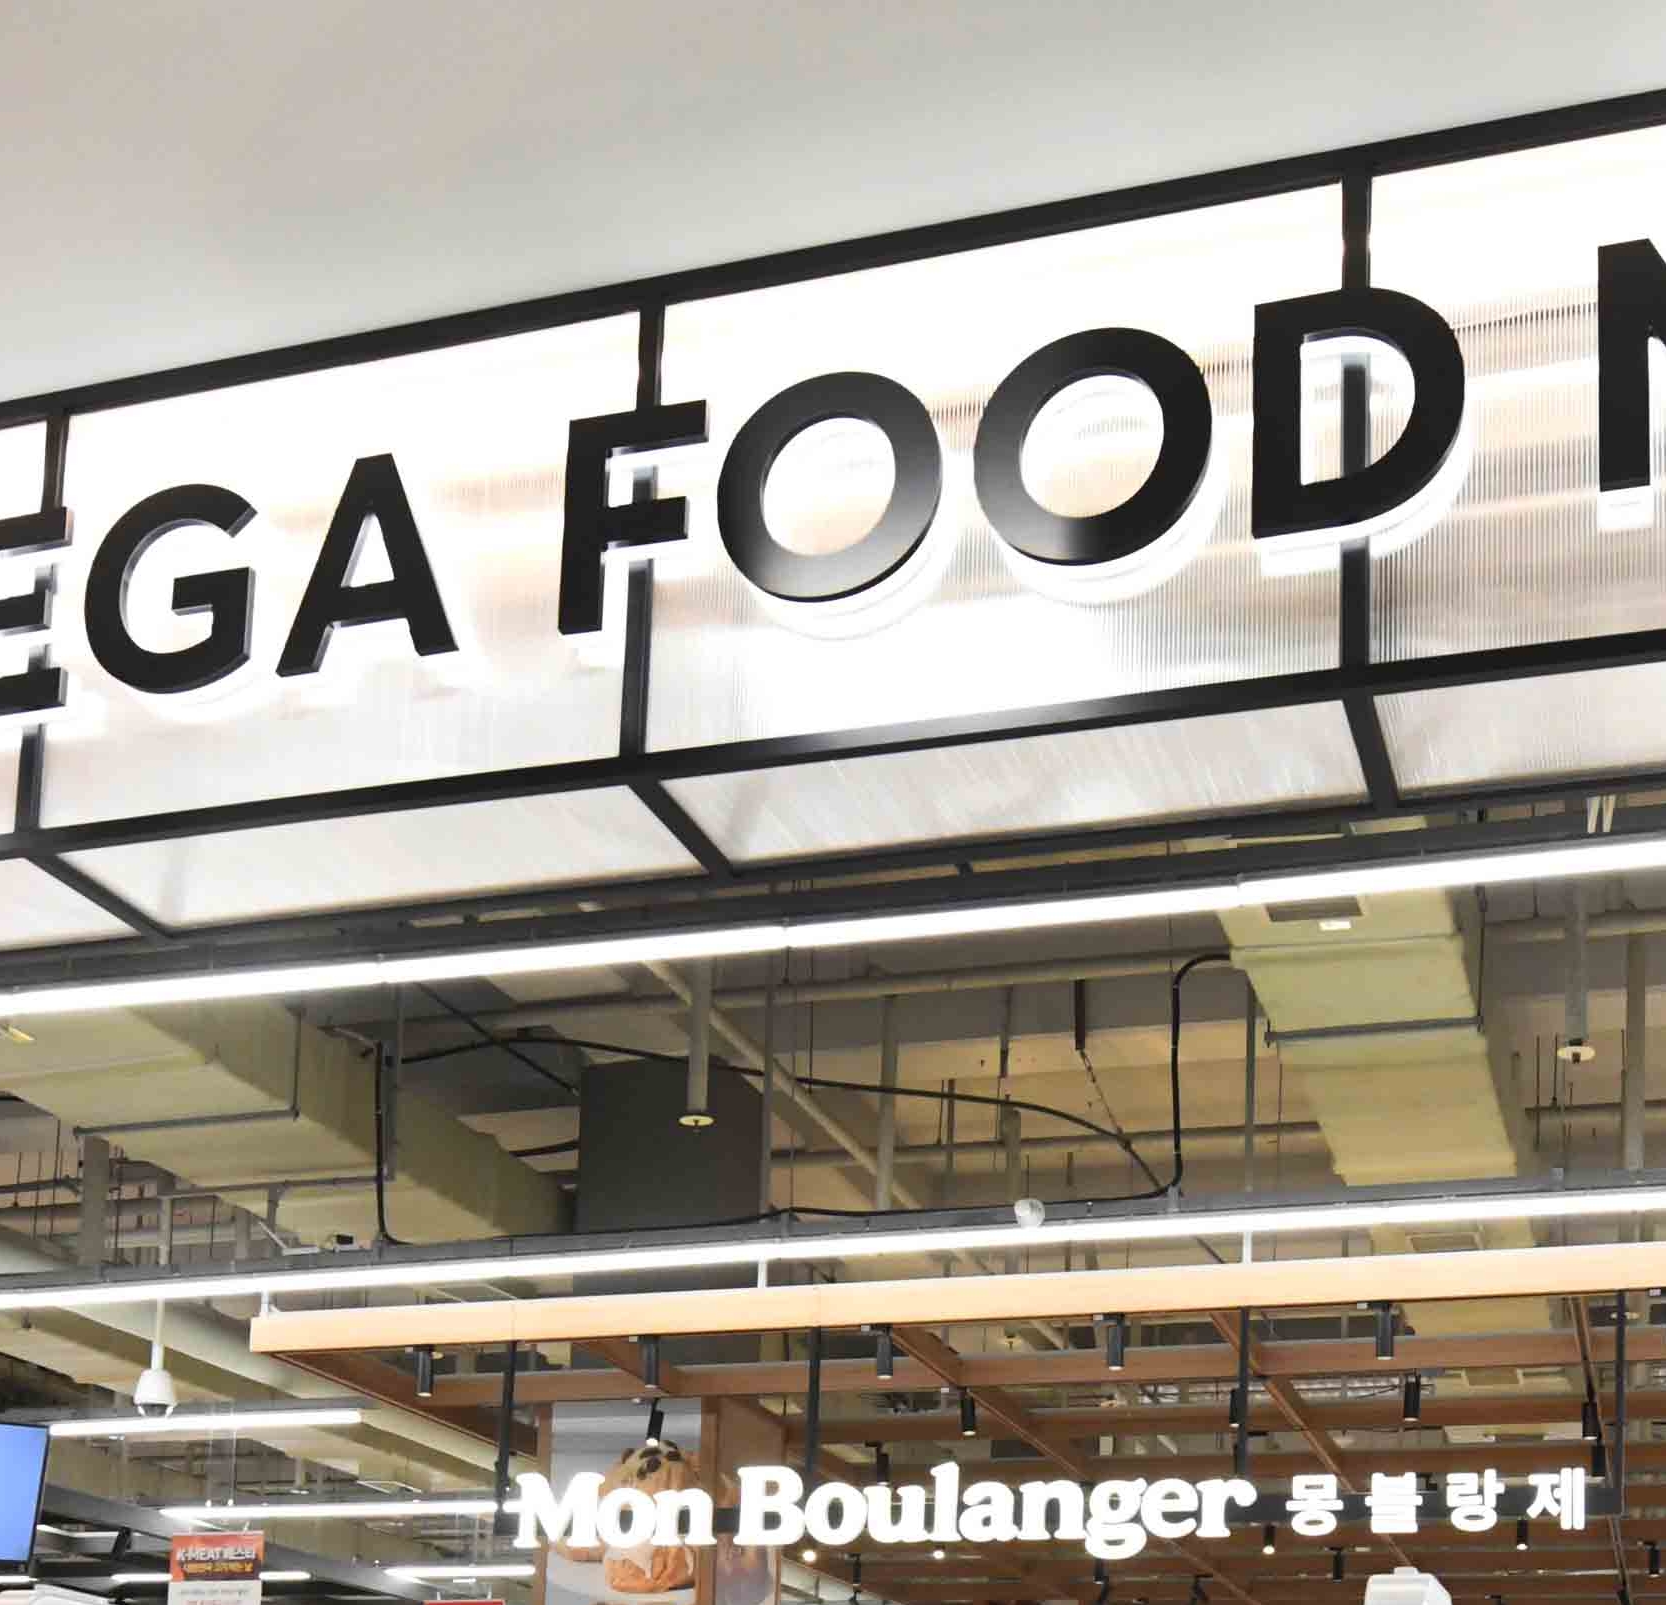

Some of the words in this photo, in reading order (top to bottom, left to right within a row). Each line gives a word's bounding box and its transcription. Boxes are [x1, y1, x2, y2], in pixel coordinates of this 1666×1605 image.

[555, 287, 1466, 635] FOOD
[512, 1470, 716, 1549] Mon
[733, 1462, 1256, 1560] Boulanger
